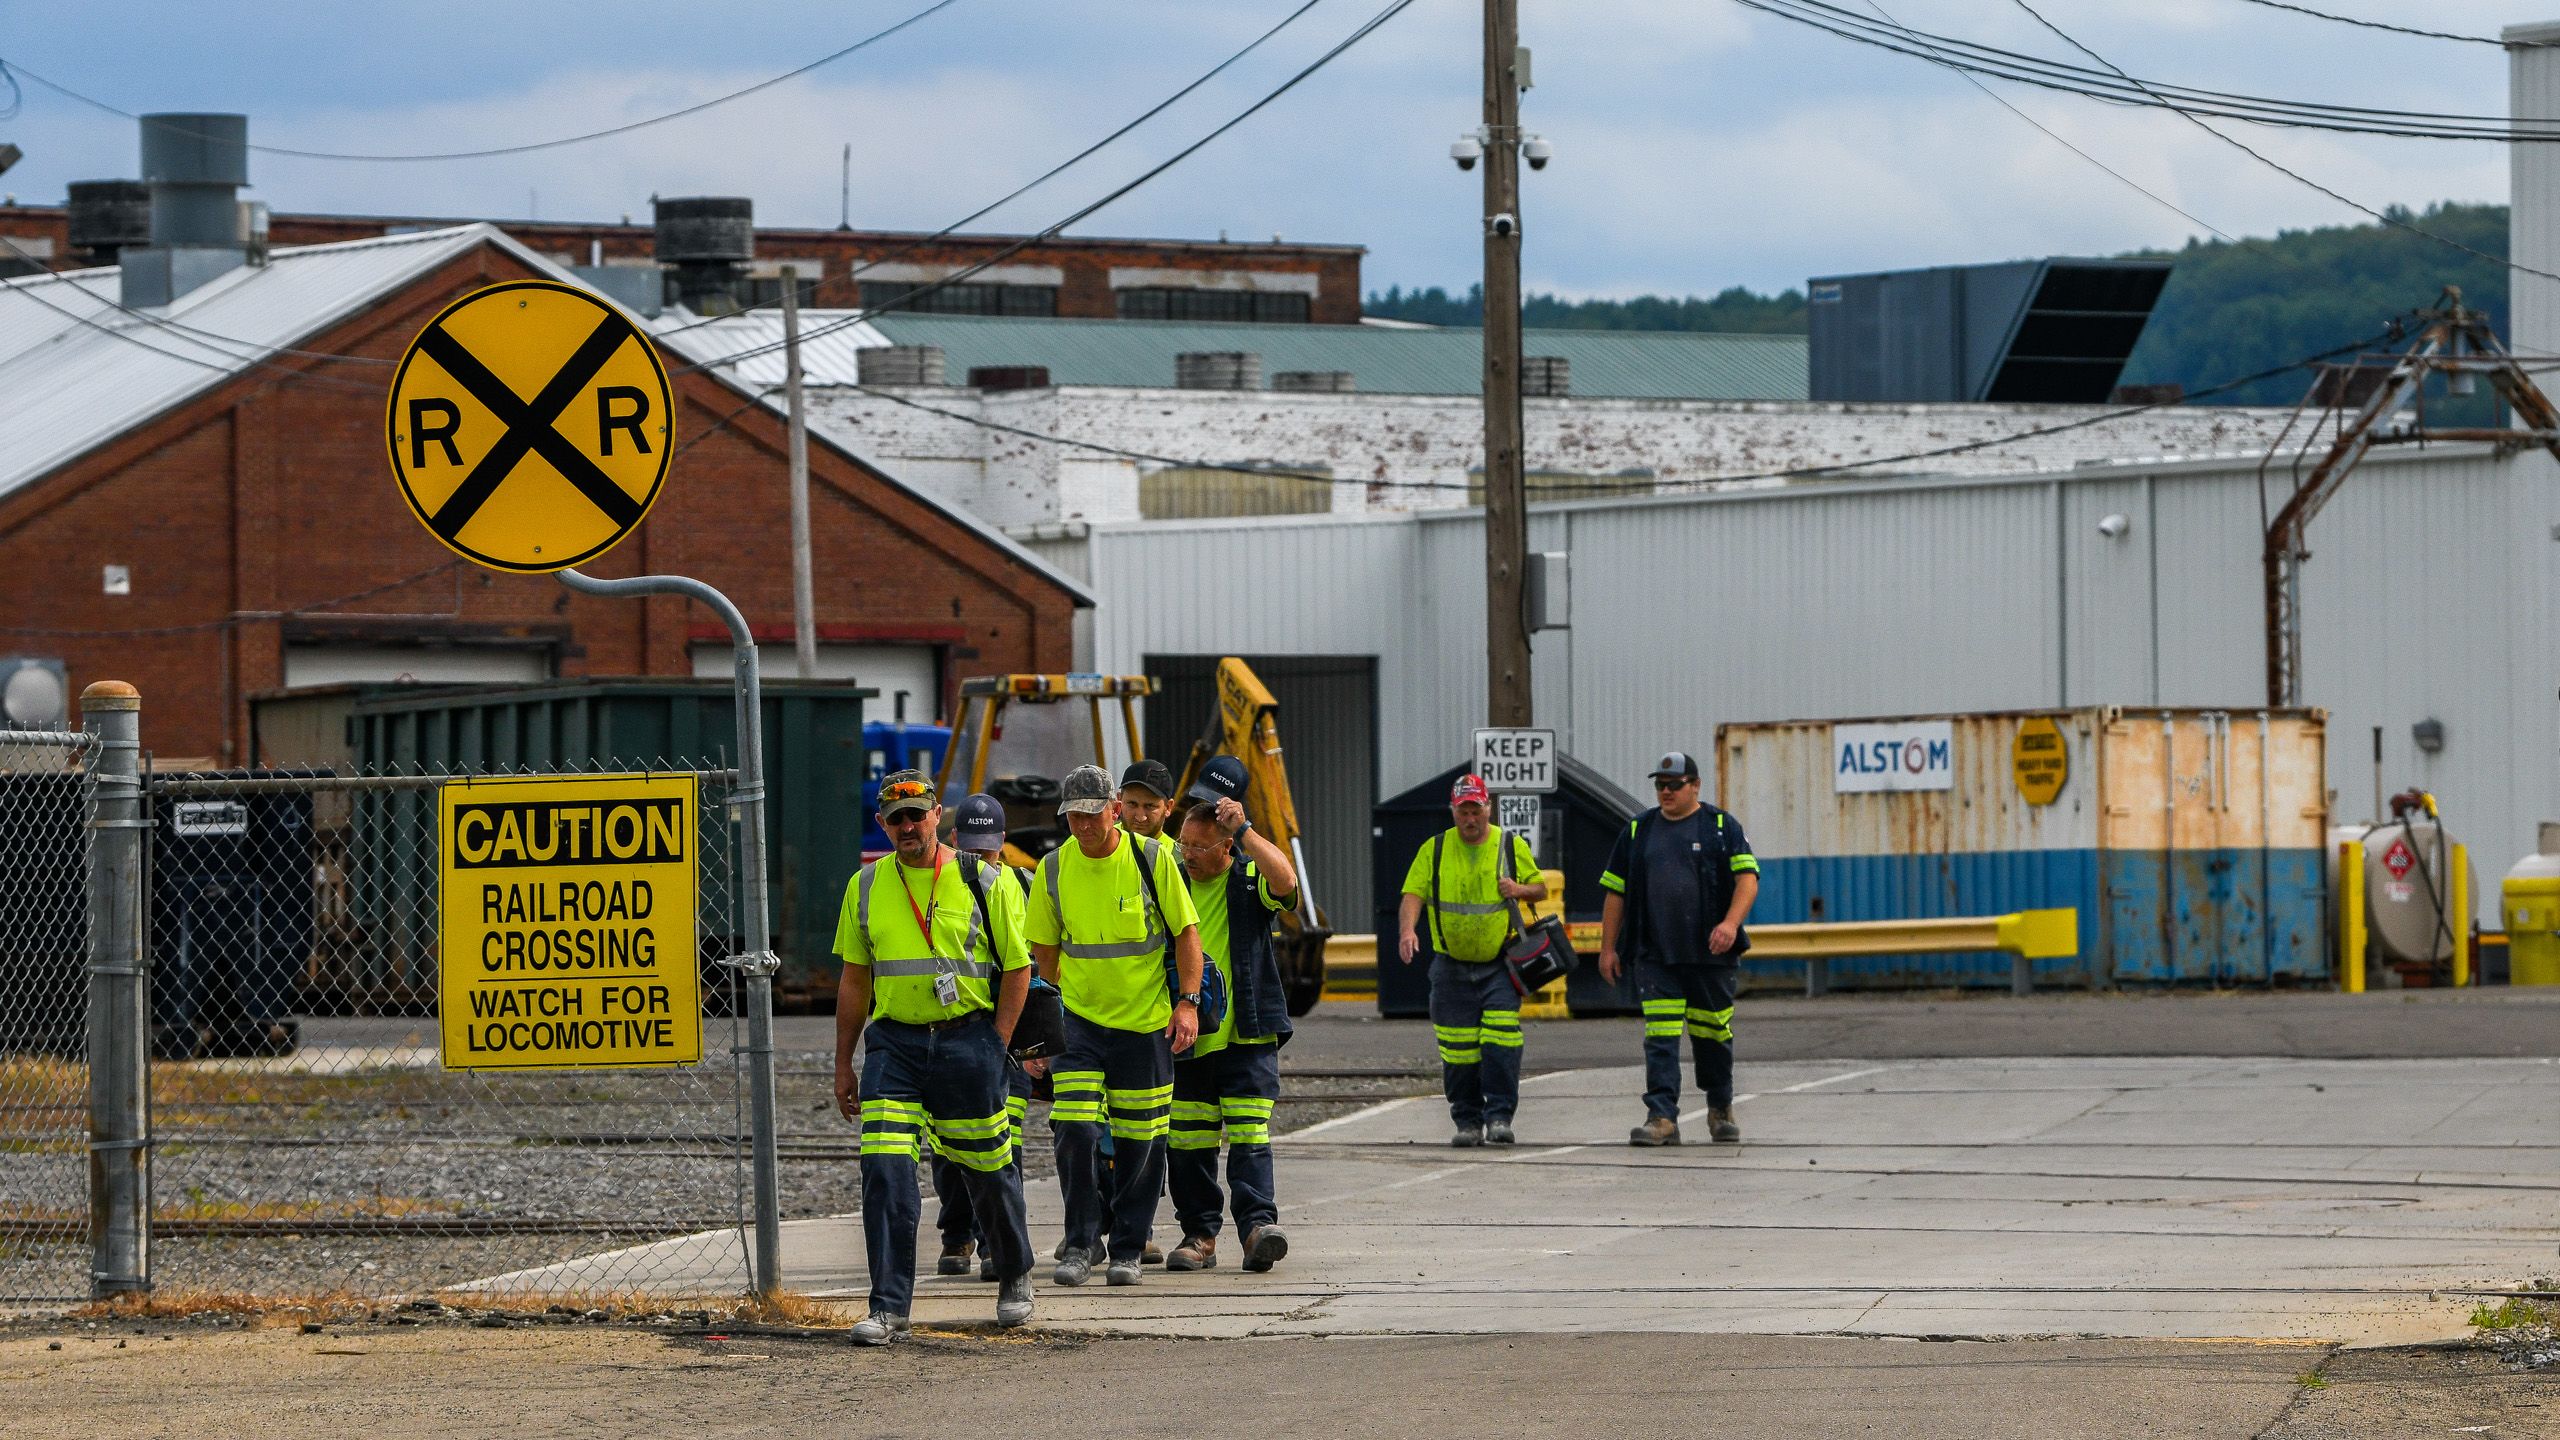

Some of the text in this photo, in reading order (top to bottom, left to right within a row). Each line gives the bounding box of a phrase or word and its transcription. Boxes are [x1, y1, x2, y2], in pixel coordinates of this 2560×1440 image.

[409, 386, 652, 468] R R
[1485, 738, 1543, 757] KEEP
[1839, 737, 1949, 774] ALSTOM
[1210, 771, 1235, 789] ALSTOM
[1482, 762, 1547, 781] RIGHT
[967, 817, 994, 826] ALSTOM
[1501, 799, 1538, 812] SPEED
[1503, 813, 1536, 826] LIMIT
[457, 804, 681, 863] CAUTION
[482, 880, 653, 924] RAILROAD
[481, 927, 656, 972] CROSSING
[469, 985, 670, 1019] WATCH FOR
[468, 1019, 674, 1052] LOCOMOTIVE
